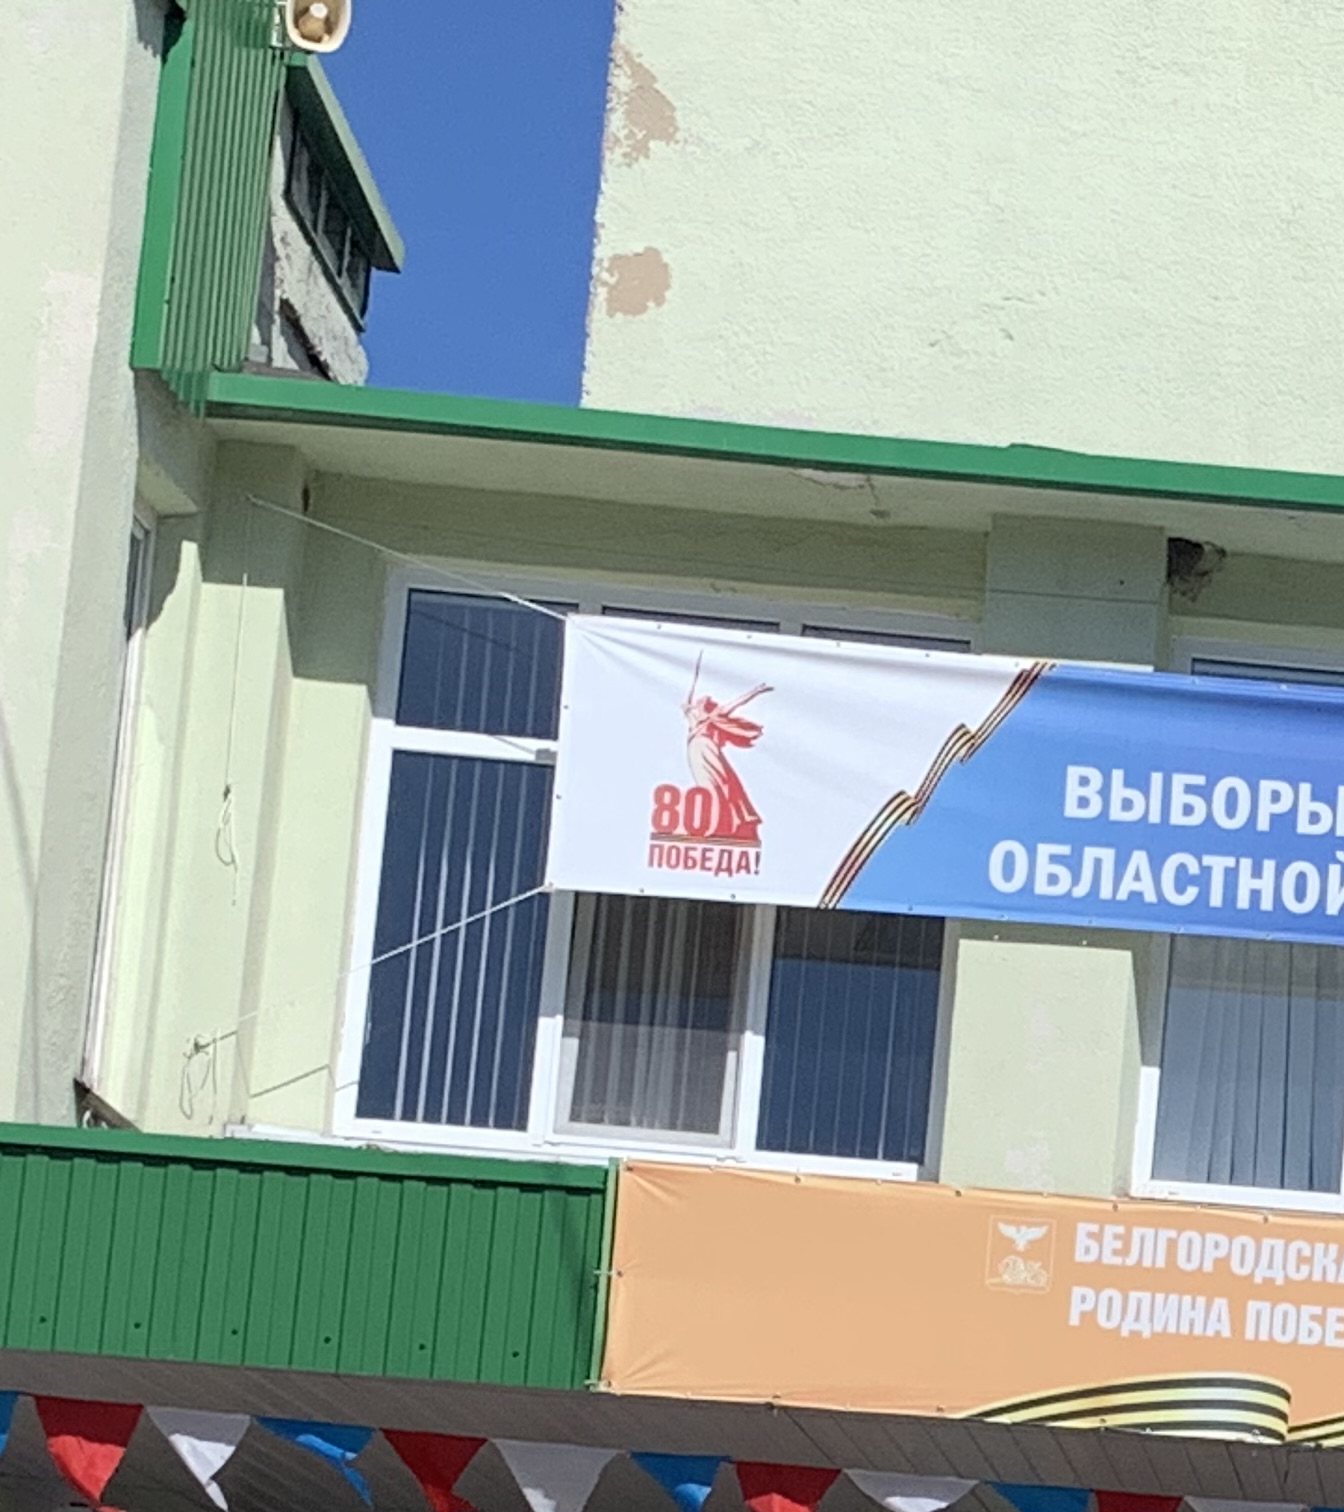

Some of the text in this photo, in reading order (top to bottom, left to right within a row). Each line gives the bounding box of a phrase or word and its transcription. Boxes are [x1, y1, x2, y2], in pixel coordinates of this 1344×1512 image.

[651, 783, 712, 836] 80
[647, 843, 762, 878] ПОБЕДА!
[1067, 1286, 1233, 1343] РОДИНА
